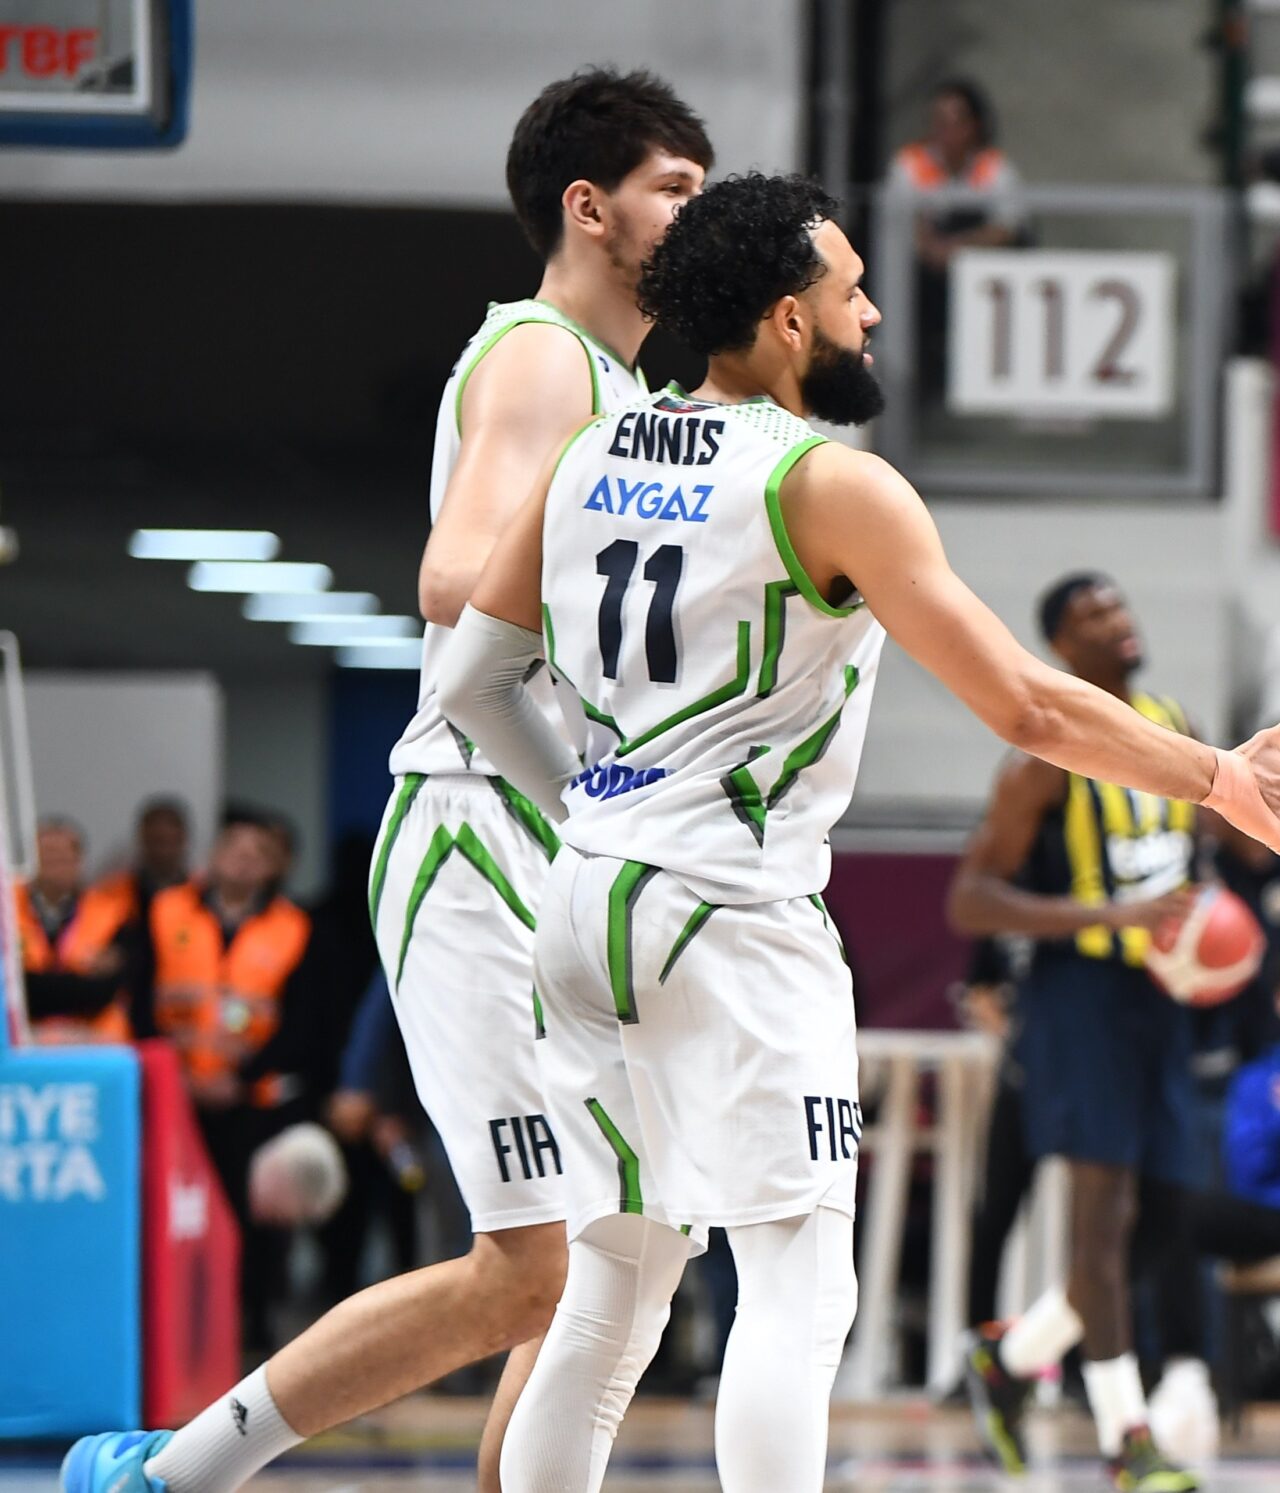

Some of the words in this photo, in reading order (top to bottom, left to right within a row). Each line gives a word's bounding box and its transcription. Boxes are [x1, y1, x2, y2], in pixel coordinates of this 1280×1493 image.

[978, 273, 1143, 386] 112
[608, 412, 726, 465] ENNIS
[583, 474, 715, 522] AYGAZ
[596, 539, 685, 684] 11
